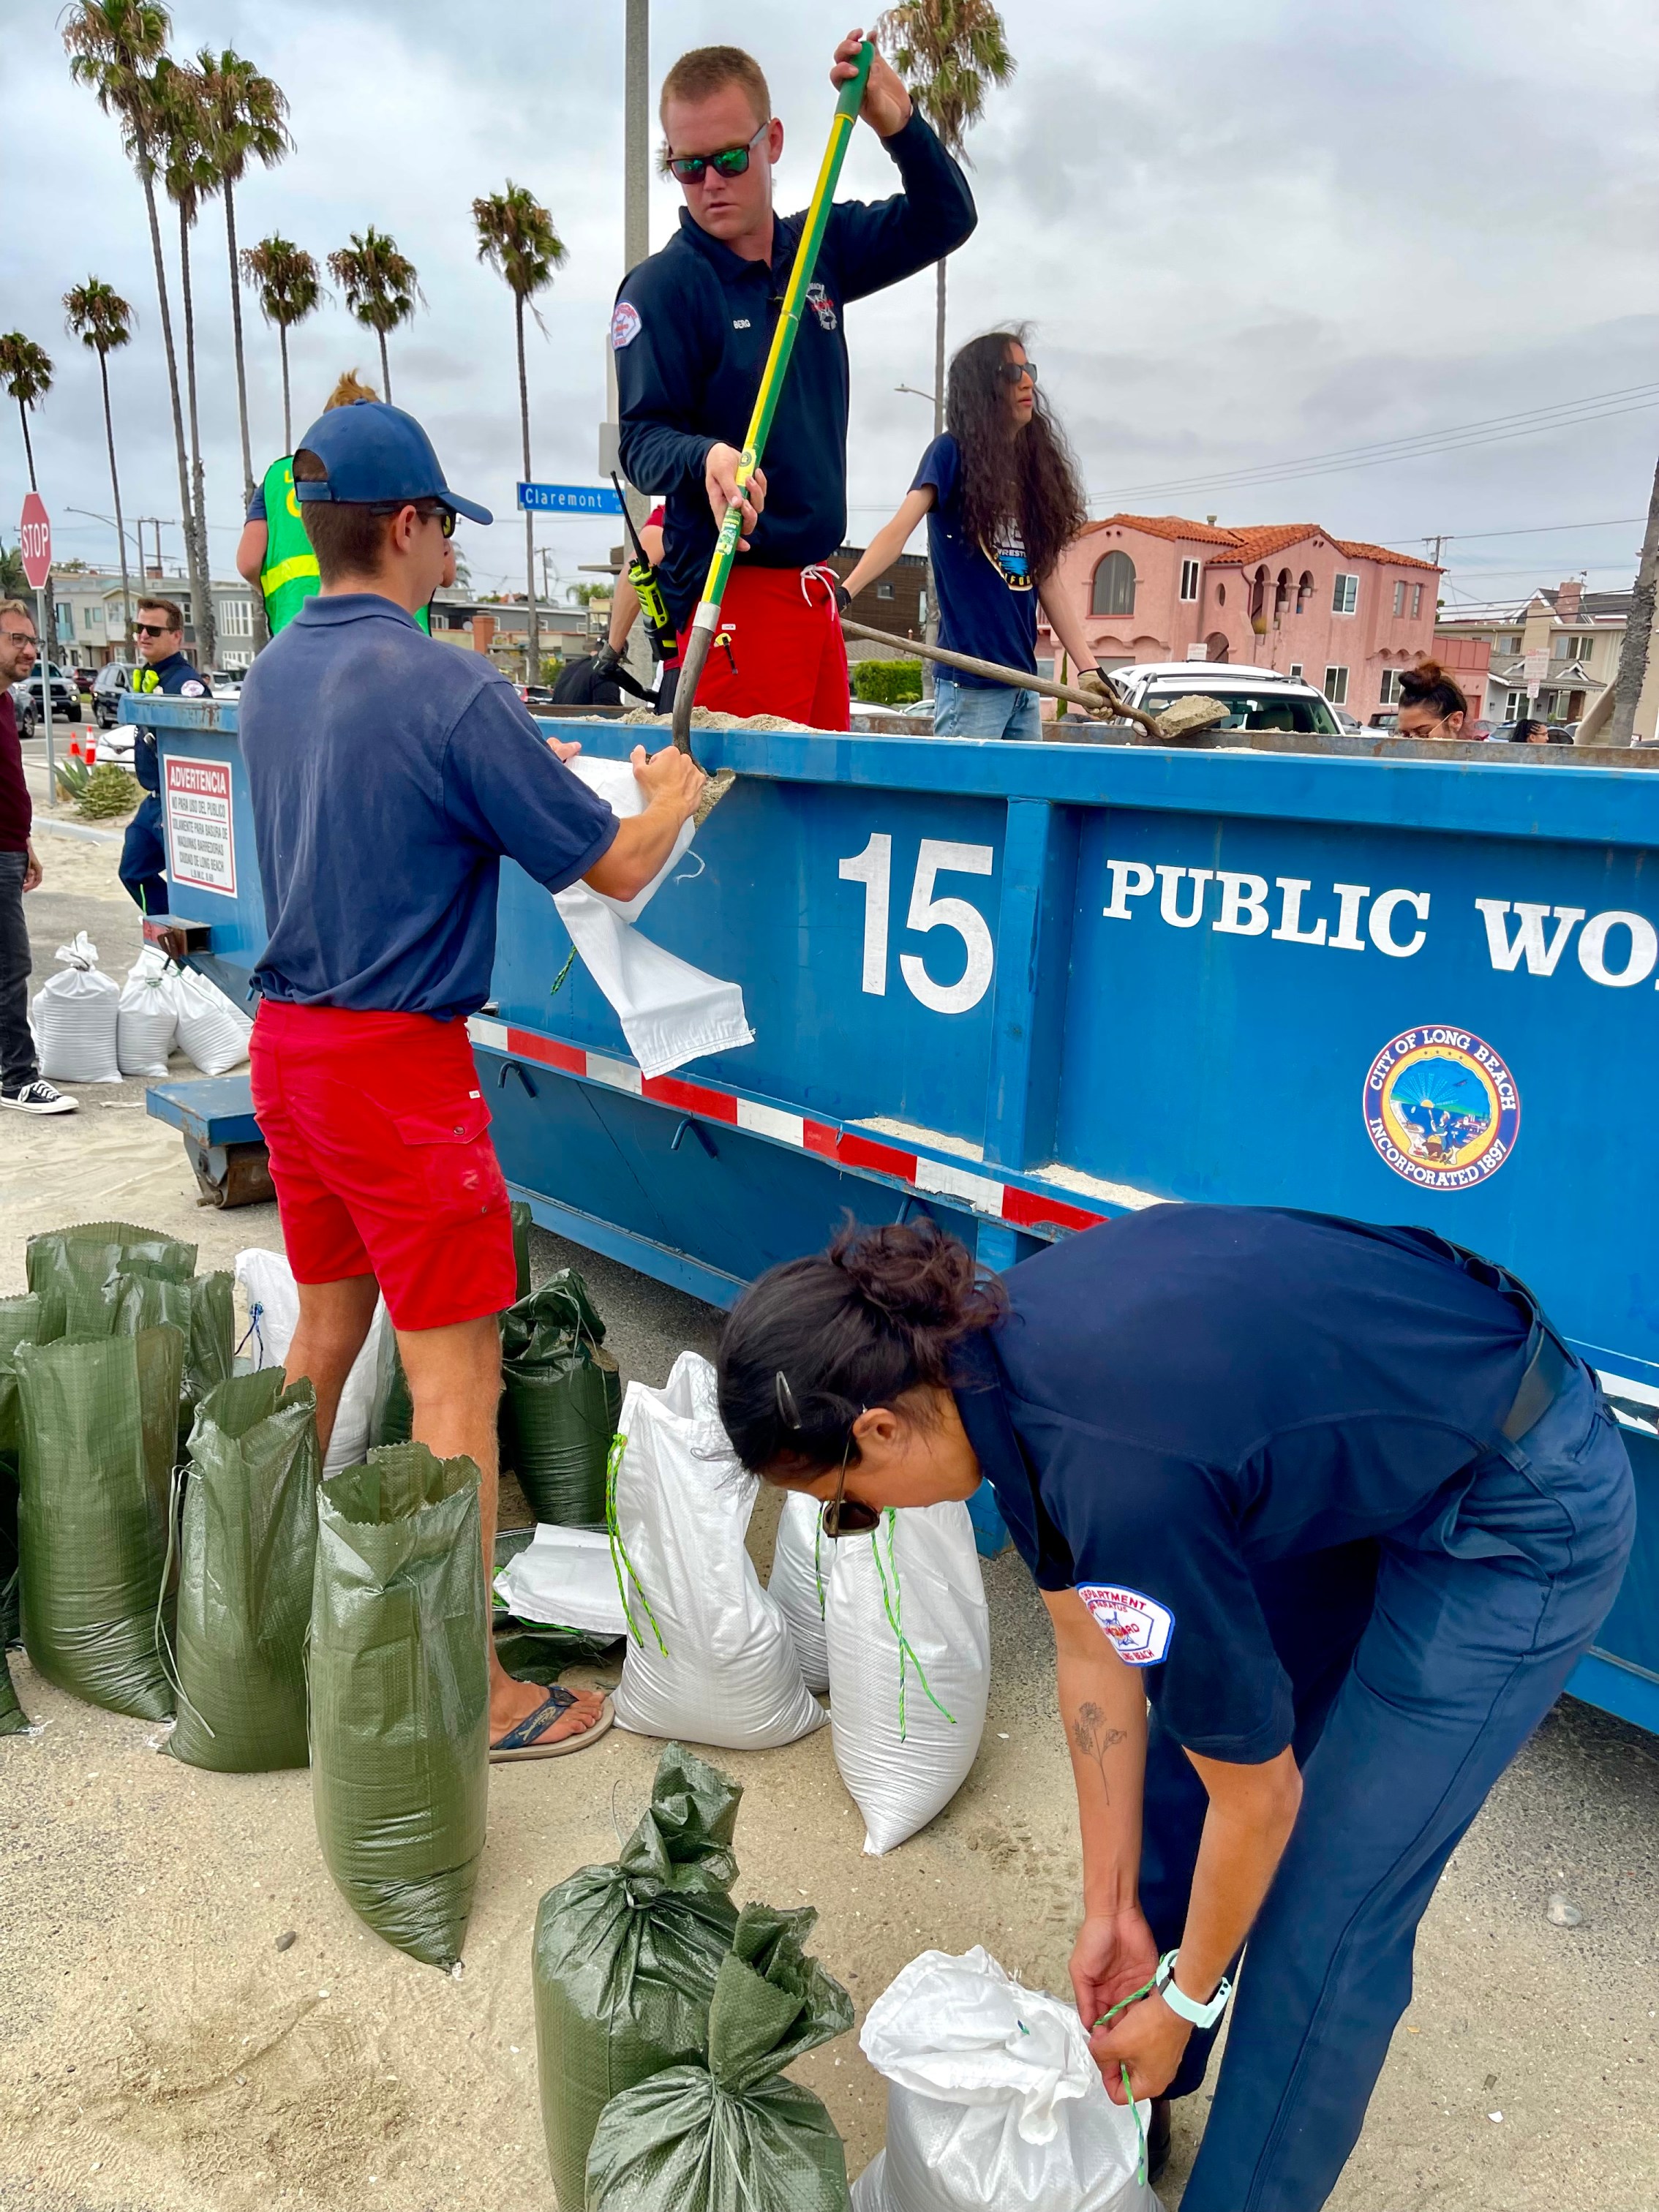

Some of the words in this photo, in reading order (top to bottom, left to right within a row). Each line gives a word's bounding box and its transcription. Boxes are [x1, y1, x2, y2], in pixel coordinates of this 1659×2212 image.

[733, 319, 751, 329] BERG
[525, 488, 602, 508] Claremont
[23, 522, 49, 558] STOP
[170, 766, 227, 794] ADVERTENCIA
[178, 797, 188, 811] PARA
[189, 799, 198, 813] USO
[198, 800, 206, 815] DEL
[207, 802, 225, 818] PUBLICO
[222, 827, 227, 840] DE
[194, 854, 199, 867] DE
[200, 856, 210, 870] LONG
[211, 858, 224, 873] BEACH
[838, 832, 994, 1015] 15
[1102, 859, 1431, 958] PUBLIC
[1475, 898, 1659, 990] WO
[1369, 1050, 1396, 1091] CITY
[1394, 1033, 1417, 1054] OF
[1422, 1028, 1471, 1050] LONG
[1473, 1045, 1516, 1111] BEACH
[1369, 1117, 1479, 1186] INCORPORATED
[1478, 1138, 1508, 1174] 1897
[1080, 1590, 1147, 1611] DEPARTMENT
[1134, 1649, 1155, 1661] BEACH
